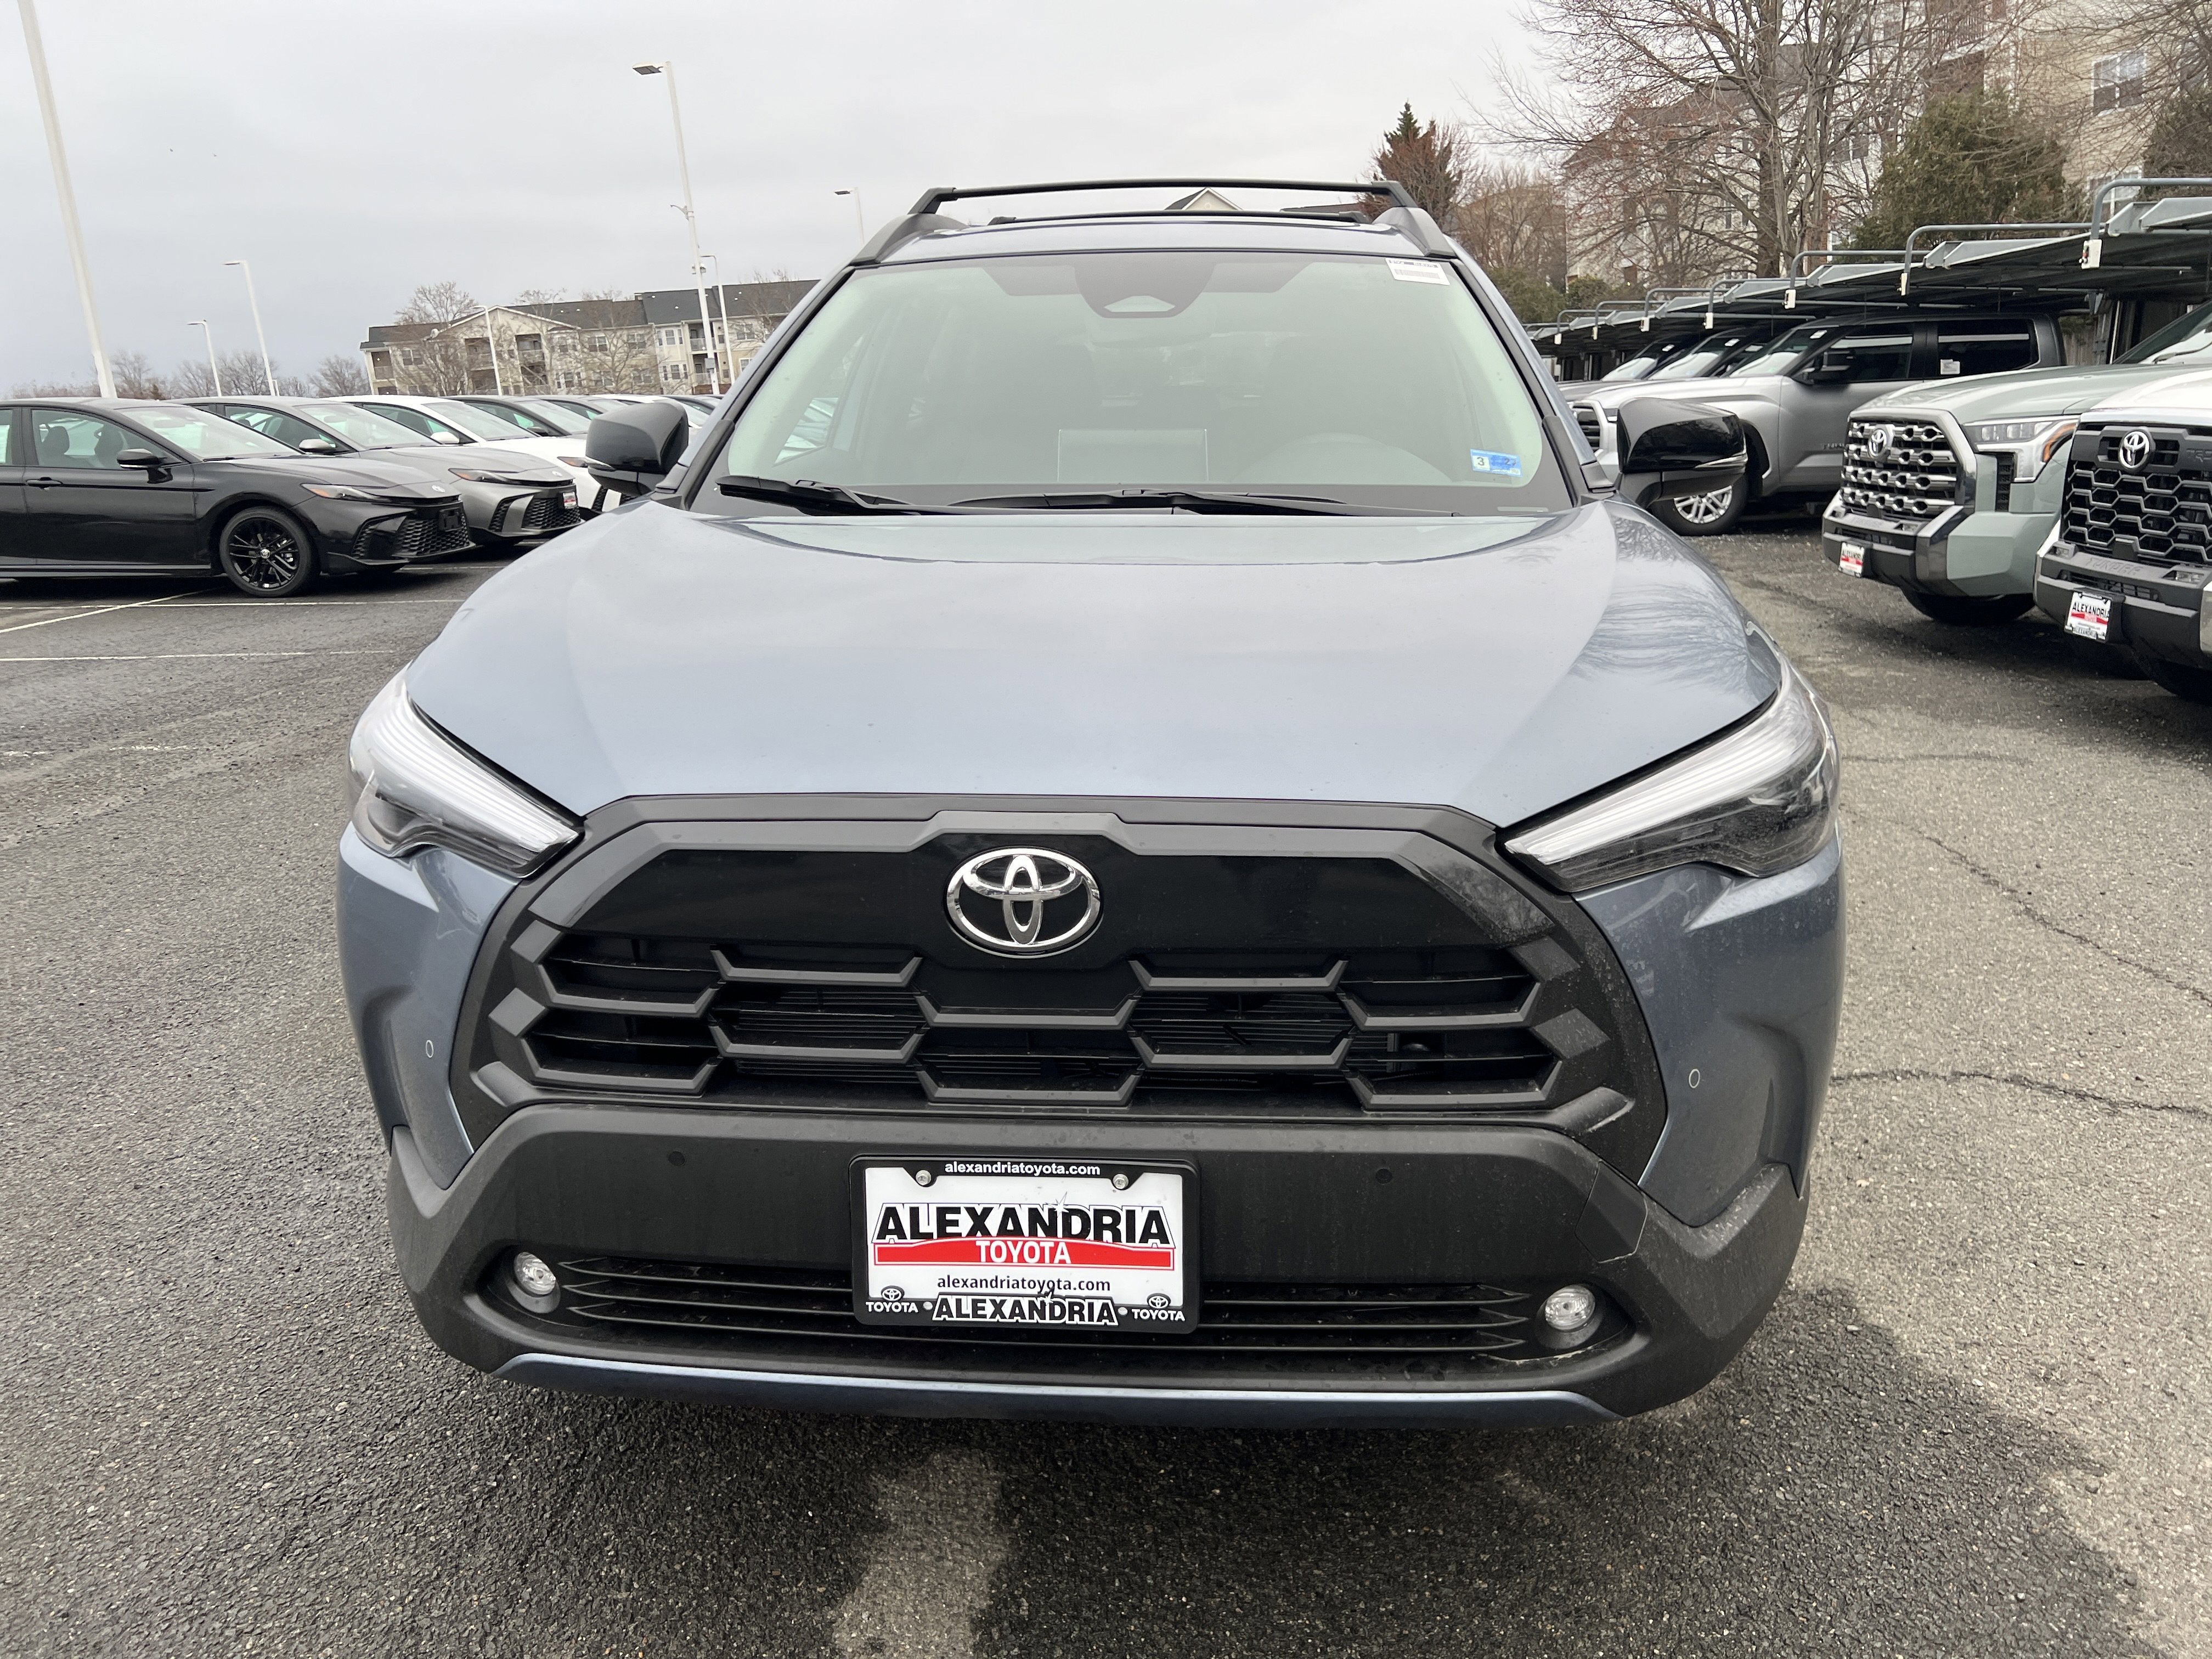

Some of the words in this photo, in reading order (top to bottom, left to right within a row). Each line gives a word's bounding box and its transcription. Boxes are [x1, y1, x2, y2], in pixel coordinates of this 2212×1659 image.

[1476, 456, 1485, 466] 3
[944, 1161, 1101, 1176] alexandriatoyota.com
[874, 1204, 1172, 1246] ALEXANDRIA
[975, 1240, 1072, 1265] TOYOTA
[937, 1274, 1111, 1293] alexandriatoyota.com
[866, 1301, 919, 1314] TOYOTA
[933, 1295, 1118, 1325] ALEXANDRIA
[1131, 1307, 1186, 1323] TOYOTA
